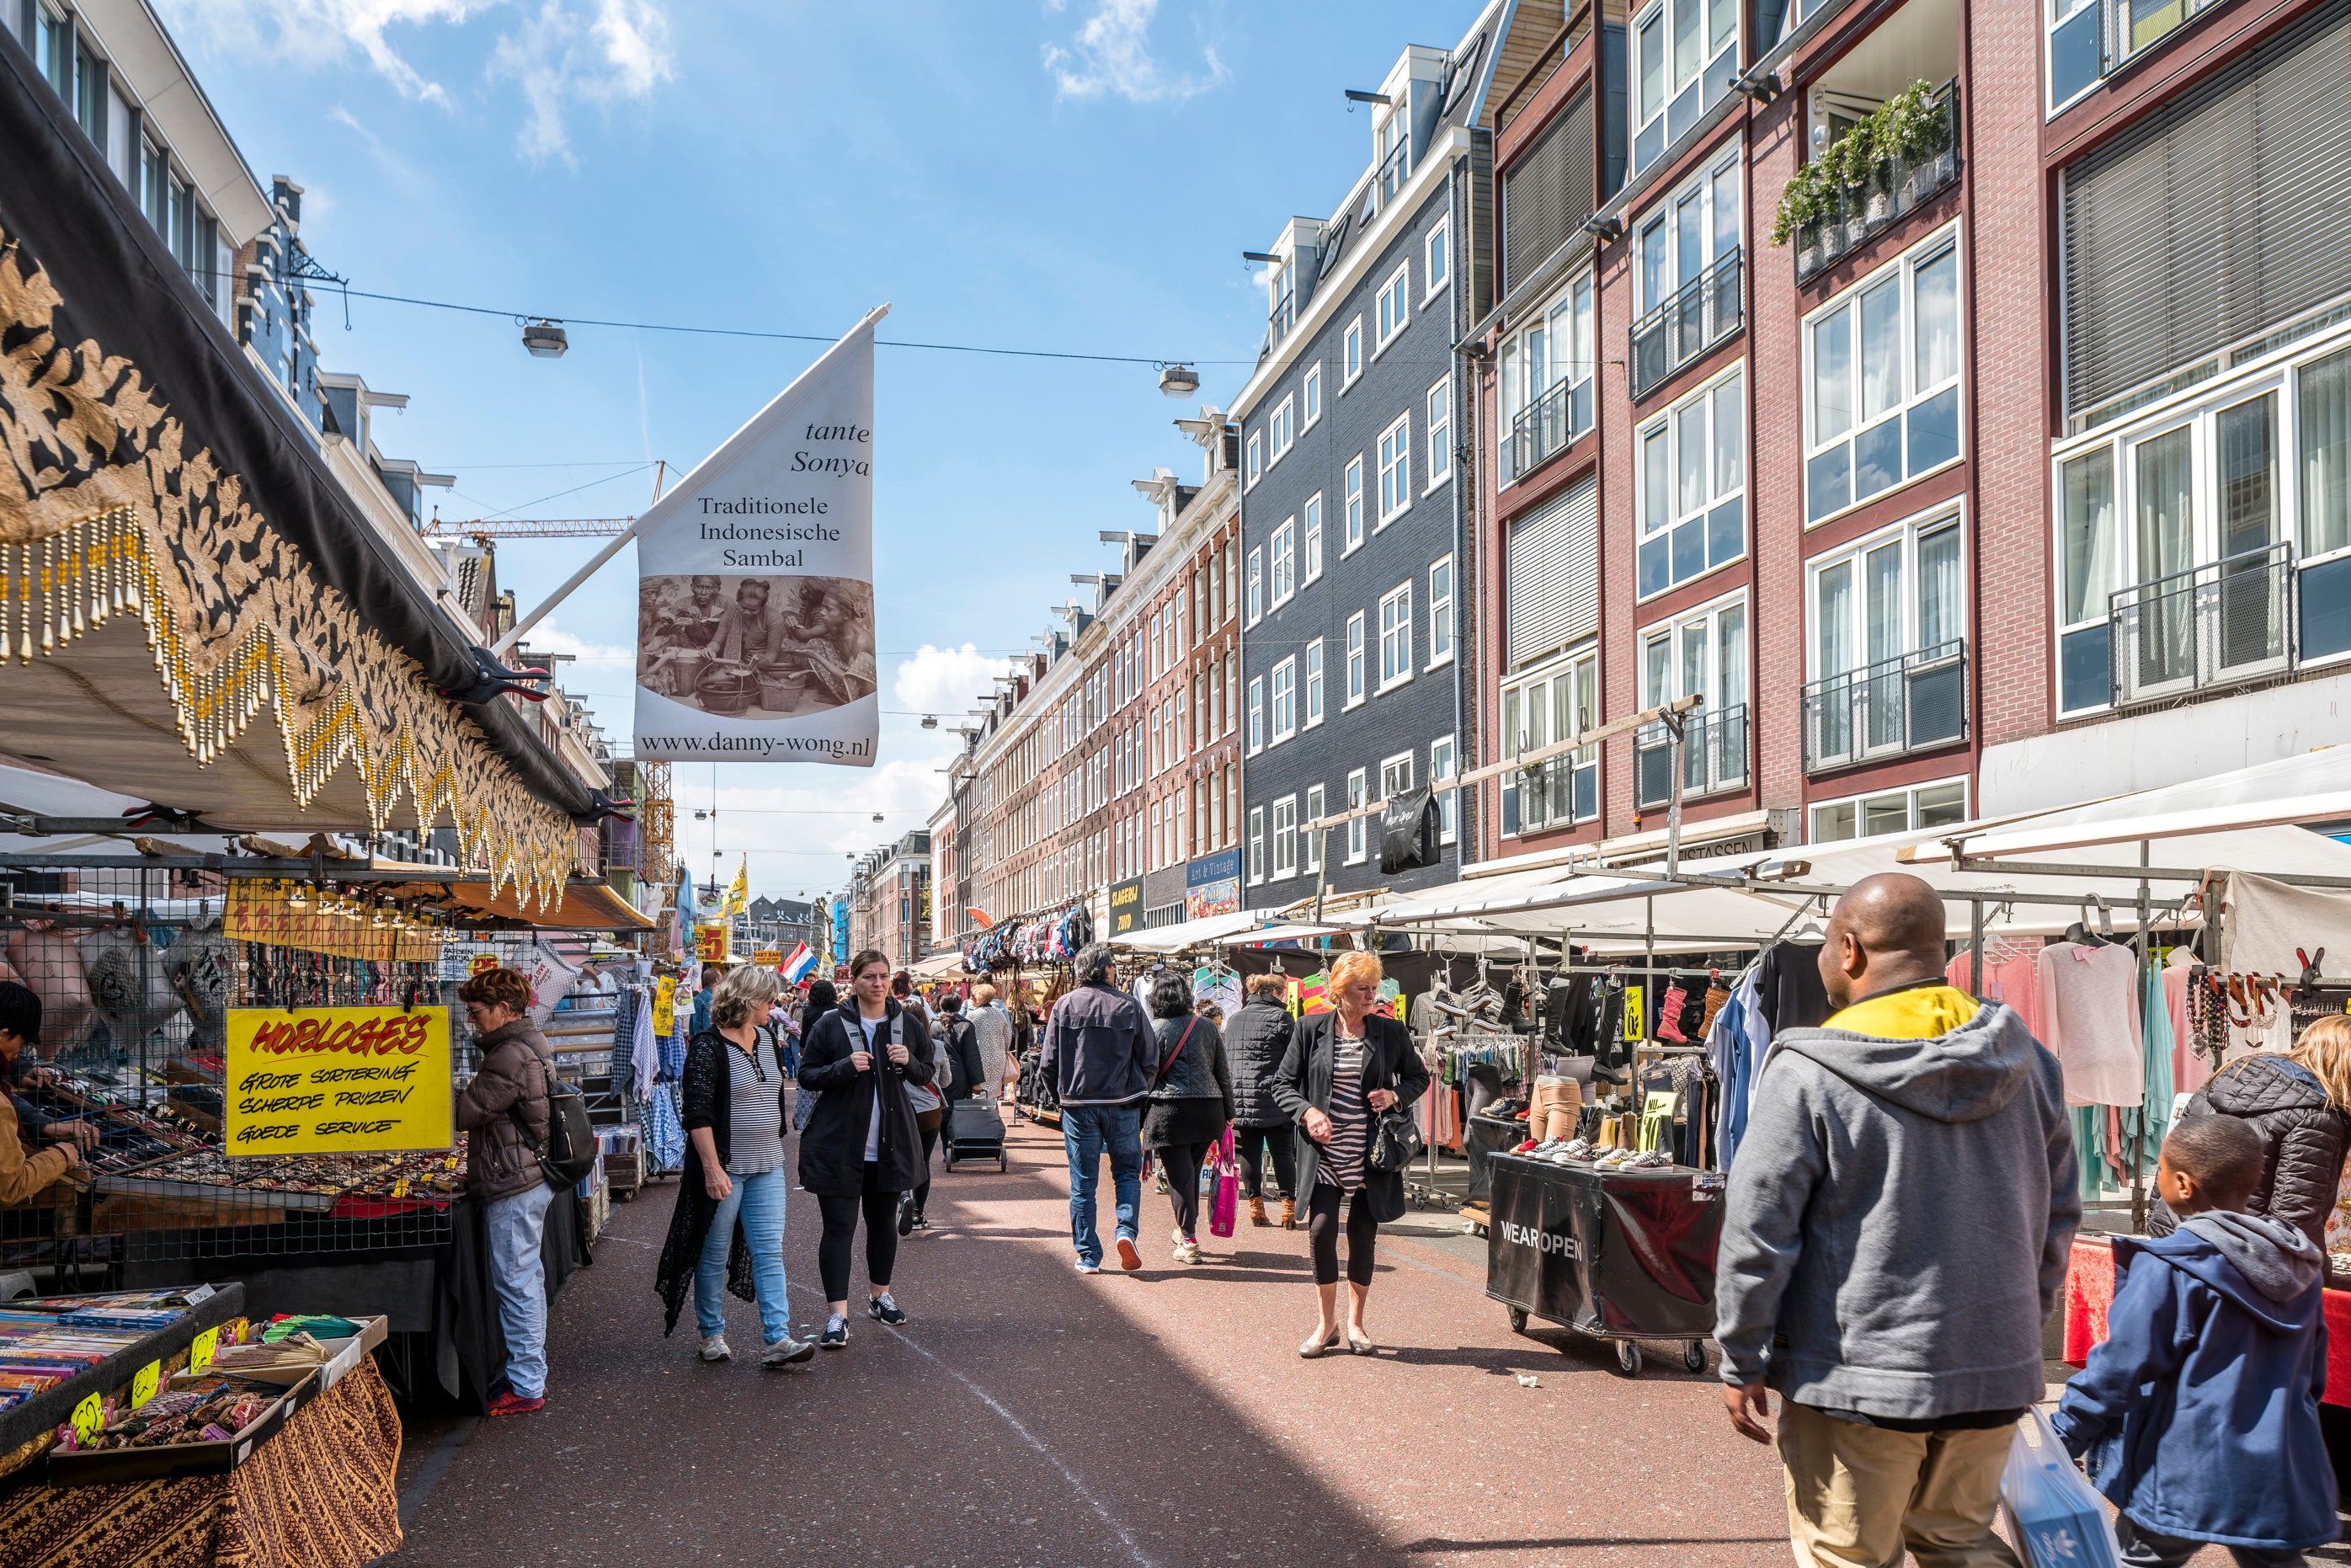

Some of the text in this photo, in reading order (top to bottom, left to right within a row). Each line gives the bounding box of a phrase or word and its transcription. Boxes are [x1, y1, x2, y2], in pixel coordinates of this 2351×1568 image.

[805, 423, 870, 443] tante
[791, 451, 870, 477] Sonya
[698, 497, 829, 515] Traditionele
[699, 523, 840, 541] Indonesische
[723, 549, 803, 567] Sambal
[641, 732, 870, 758] www.danny-wong.nl
[1191, 868, 1202, 881] Art
[1209, 859, 1234, 875] Vintage
[1112, 885, 1138, 908] SLAGERIJ
[1117, 914, 1132, 931] ZUID
[249, 1015, 432, 1058] HORLOGES
[239, 1061, 419, 1094] GROTE SORTERING
[238, 1085, 414, 1114] SCHERPE PRIJZEN
[237, 1120, 402, 1144] GOEDE SERVICE
